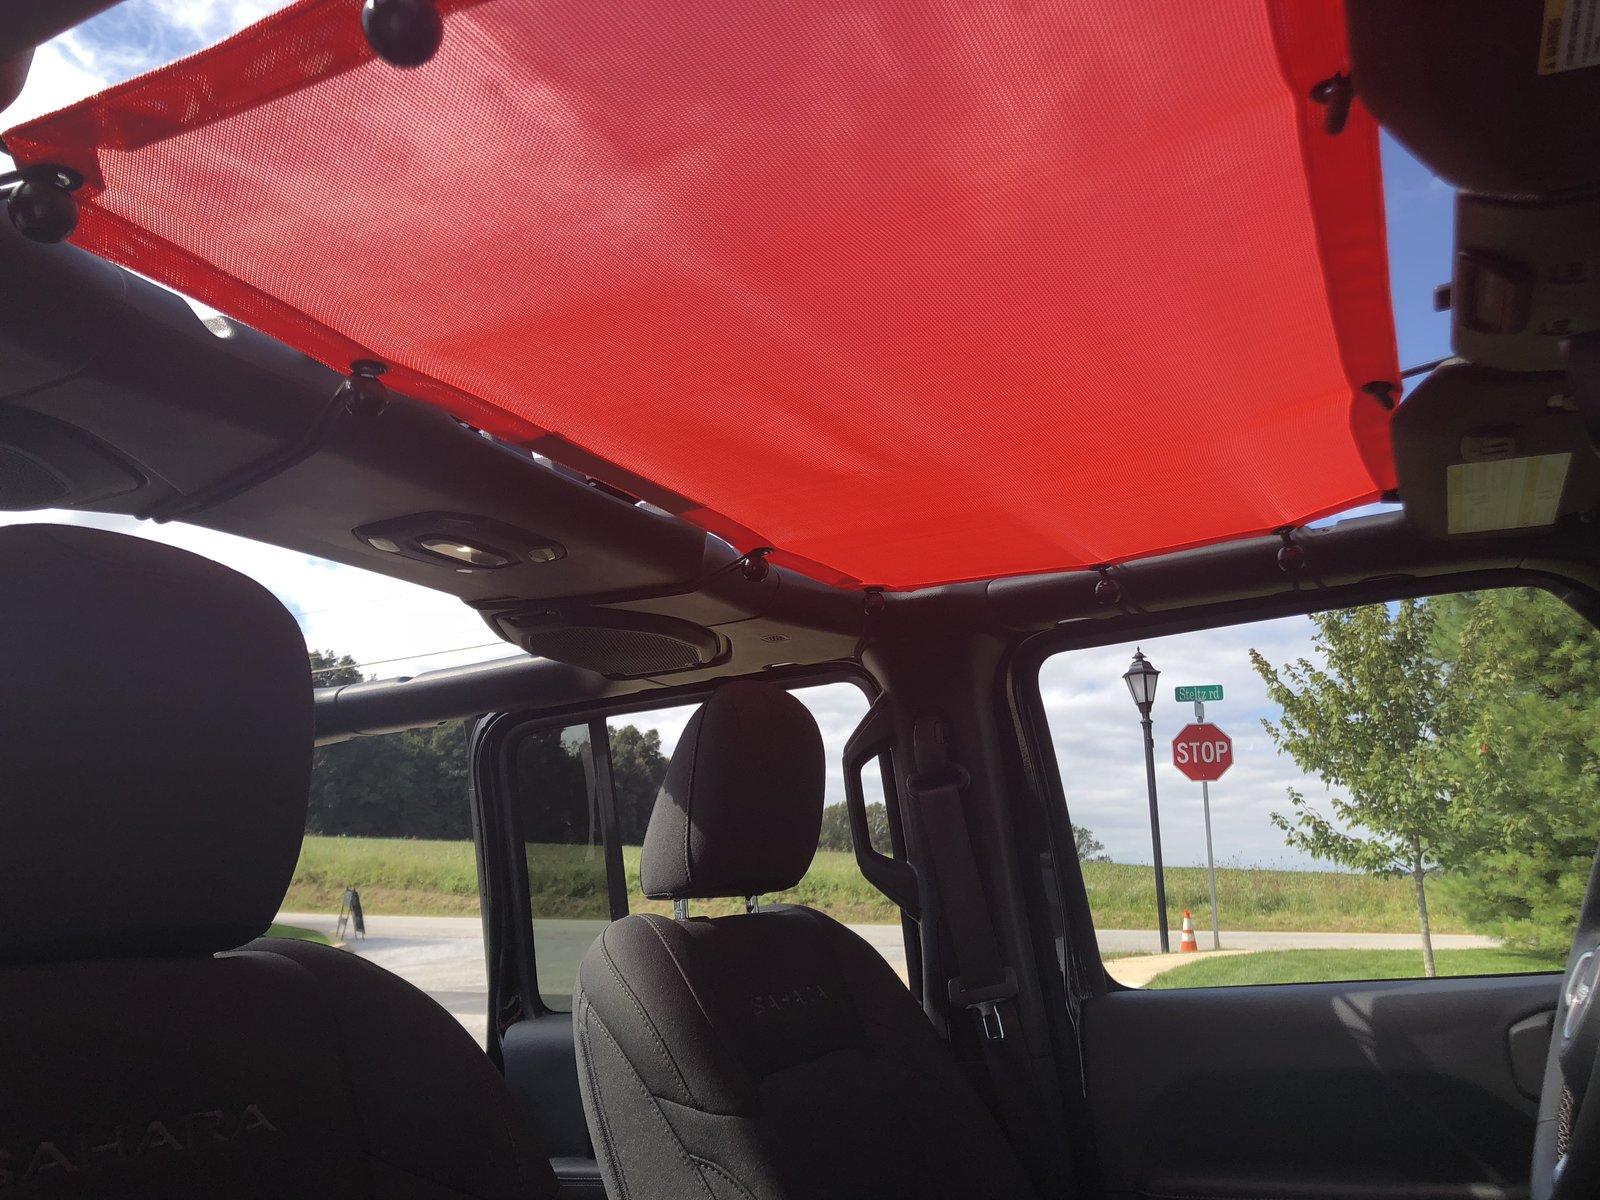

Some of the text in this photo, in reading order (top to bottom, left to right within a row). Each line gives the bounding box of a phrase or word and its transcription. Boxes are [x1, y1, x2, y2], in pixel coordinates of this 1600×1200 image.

[1180, 686, 1220, 701] Steltz rd
[1177, 741, 1228, 764] STOP
